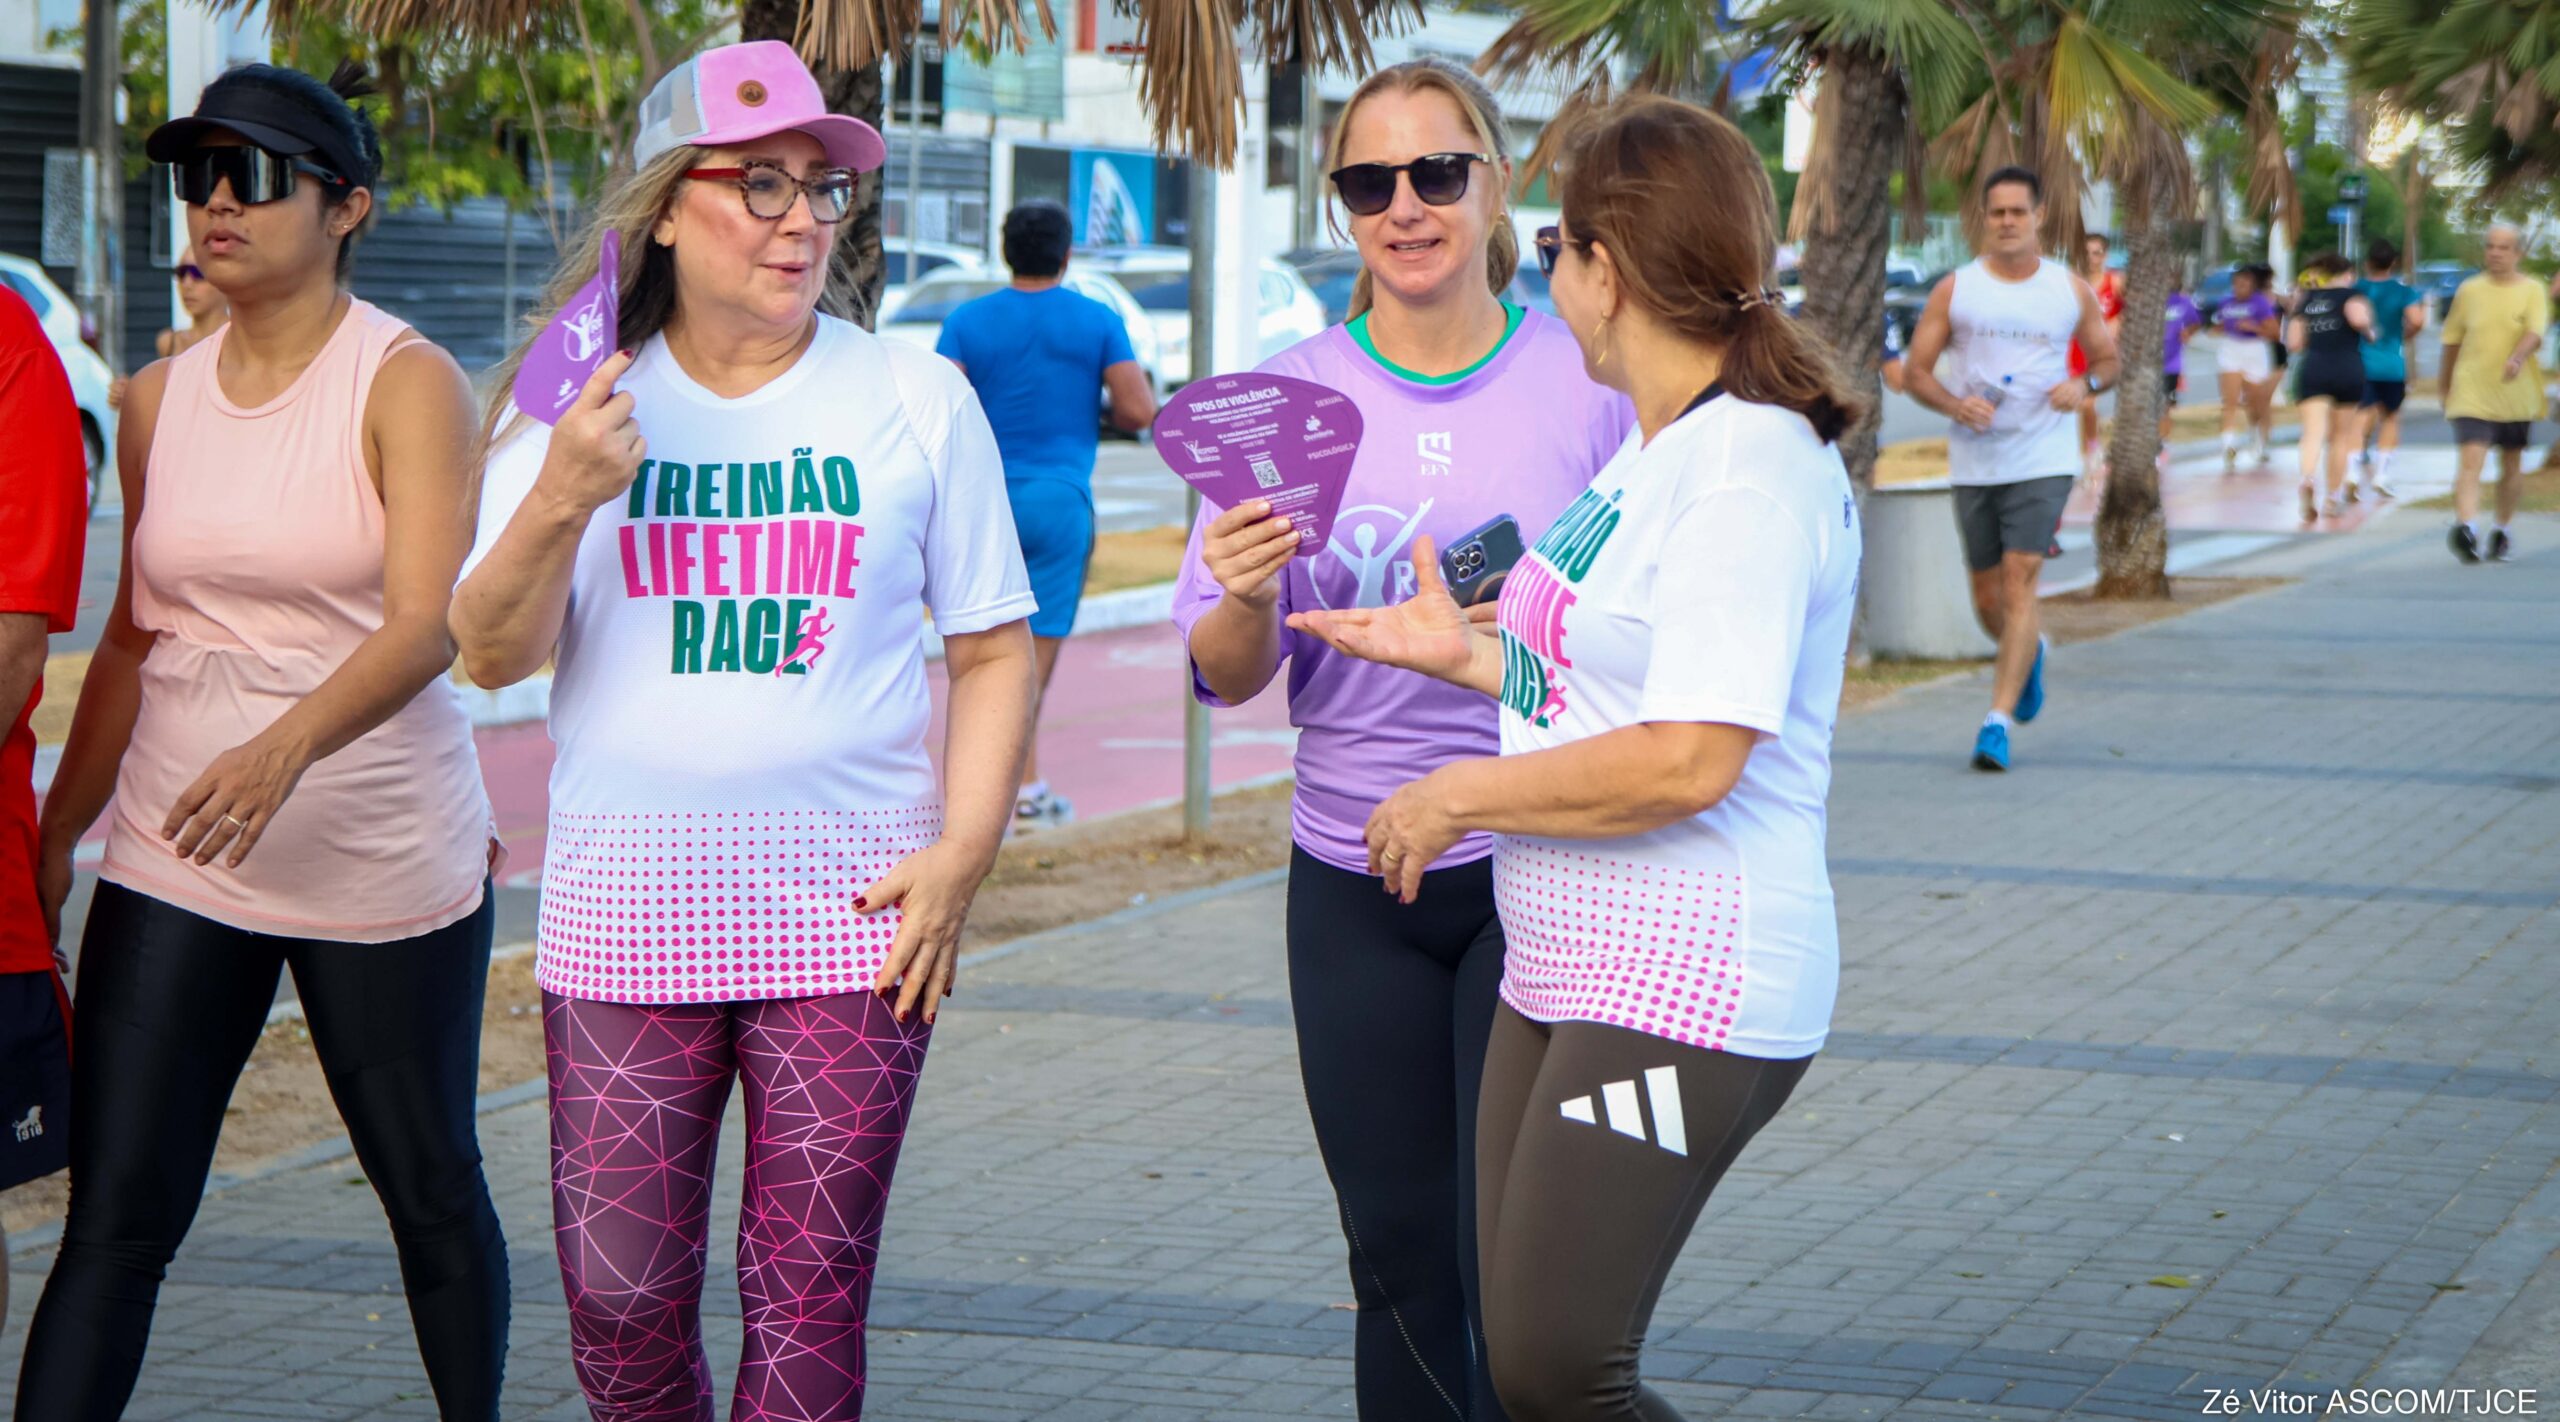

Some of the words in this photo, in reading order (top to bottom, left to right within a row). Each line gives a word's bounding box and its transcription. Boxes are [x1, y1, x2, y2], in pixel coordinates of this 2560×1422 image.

[1188, 400, 1216, 413] TIPOS
[1215, 398, 1230, 409] DE
[1228, 386, 1281, 406] VIOLÊNCIA
[628, 447, 861, 518] TREINÃO
[1307, 442, 1356, 460] PSICOLÓGICA
[618, 519, 865, 599] LIFETIME
[671, 598, 811, 675] RACE
